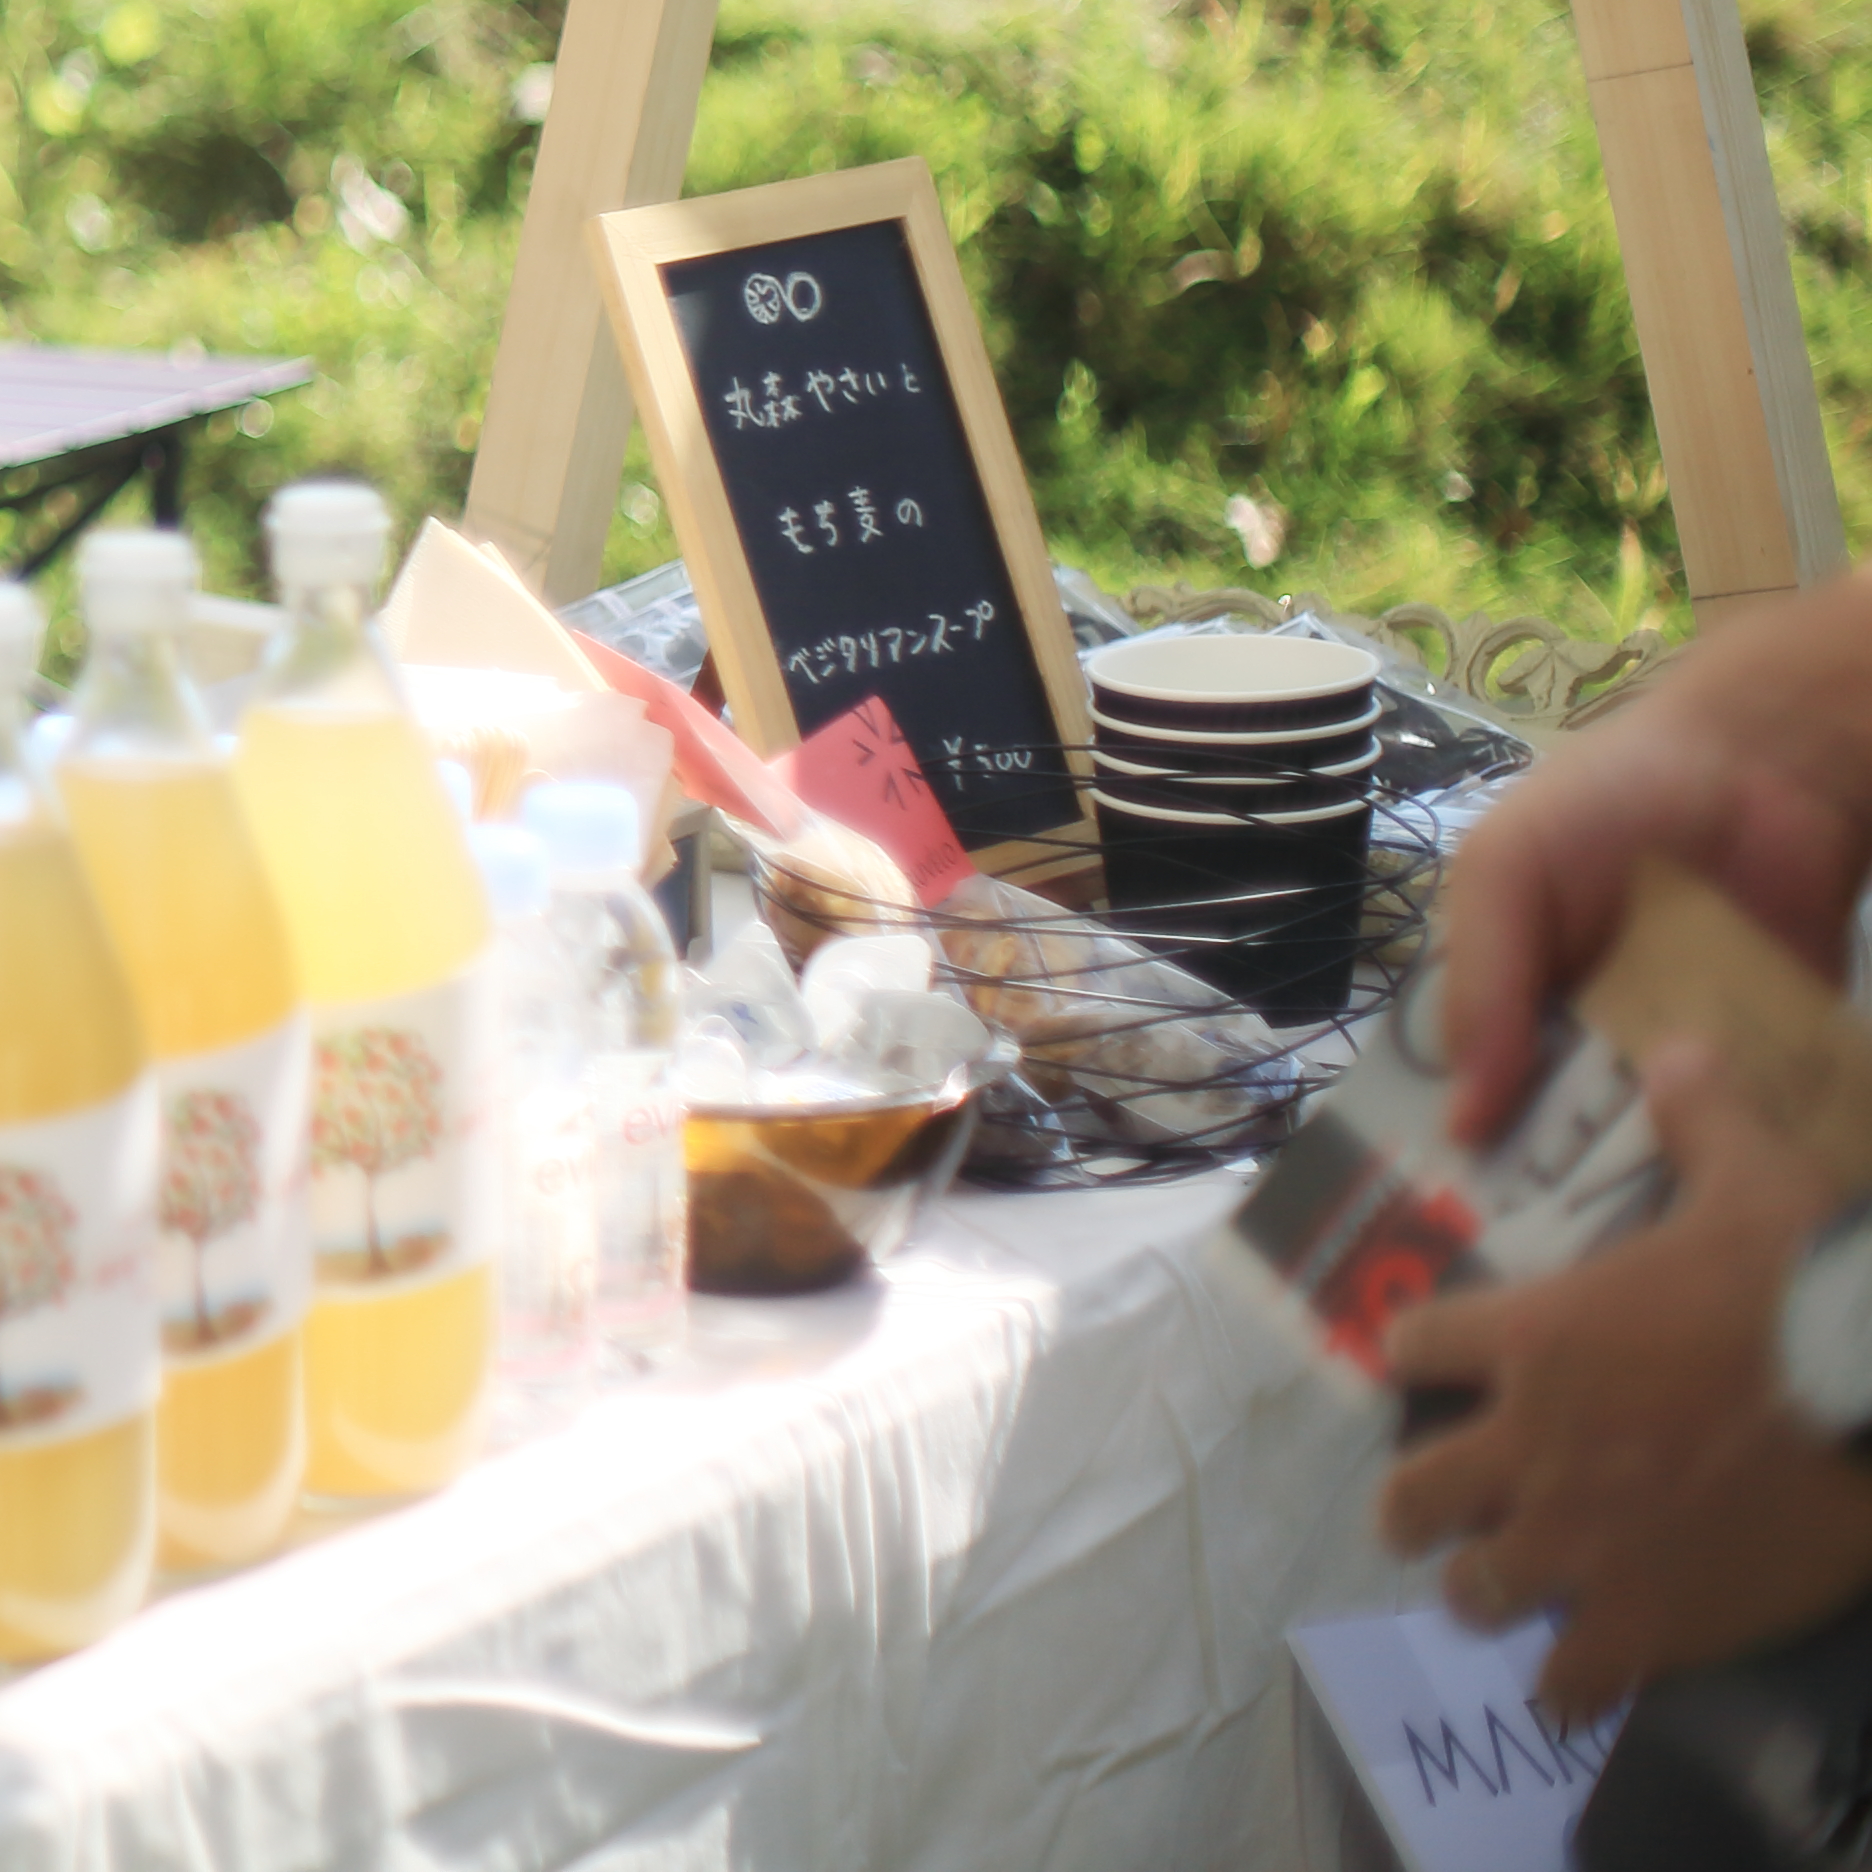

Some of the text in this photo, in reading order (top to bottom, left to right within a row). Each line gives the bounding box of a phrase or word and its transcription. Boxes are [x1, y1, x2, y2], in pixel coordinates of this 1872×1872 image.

[723, 362, 922, 430] 丸森やさいと
[777, 484, 924, 555] もち麦の
[787, 598, 995, 685] ベジタリアンスープ
